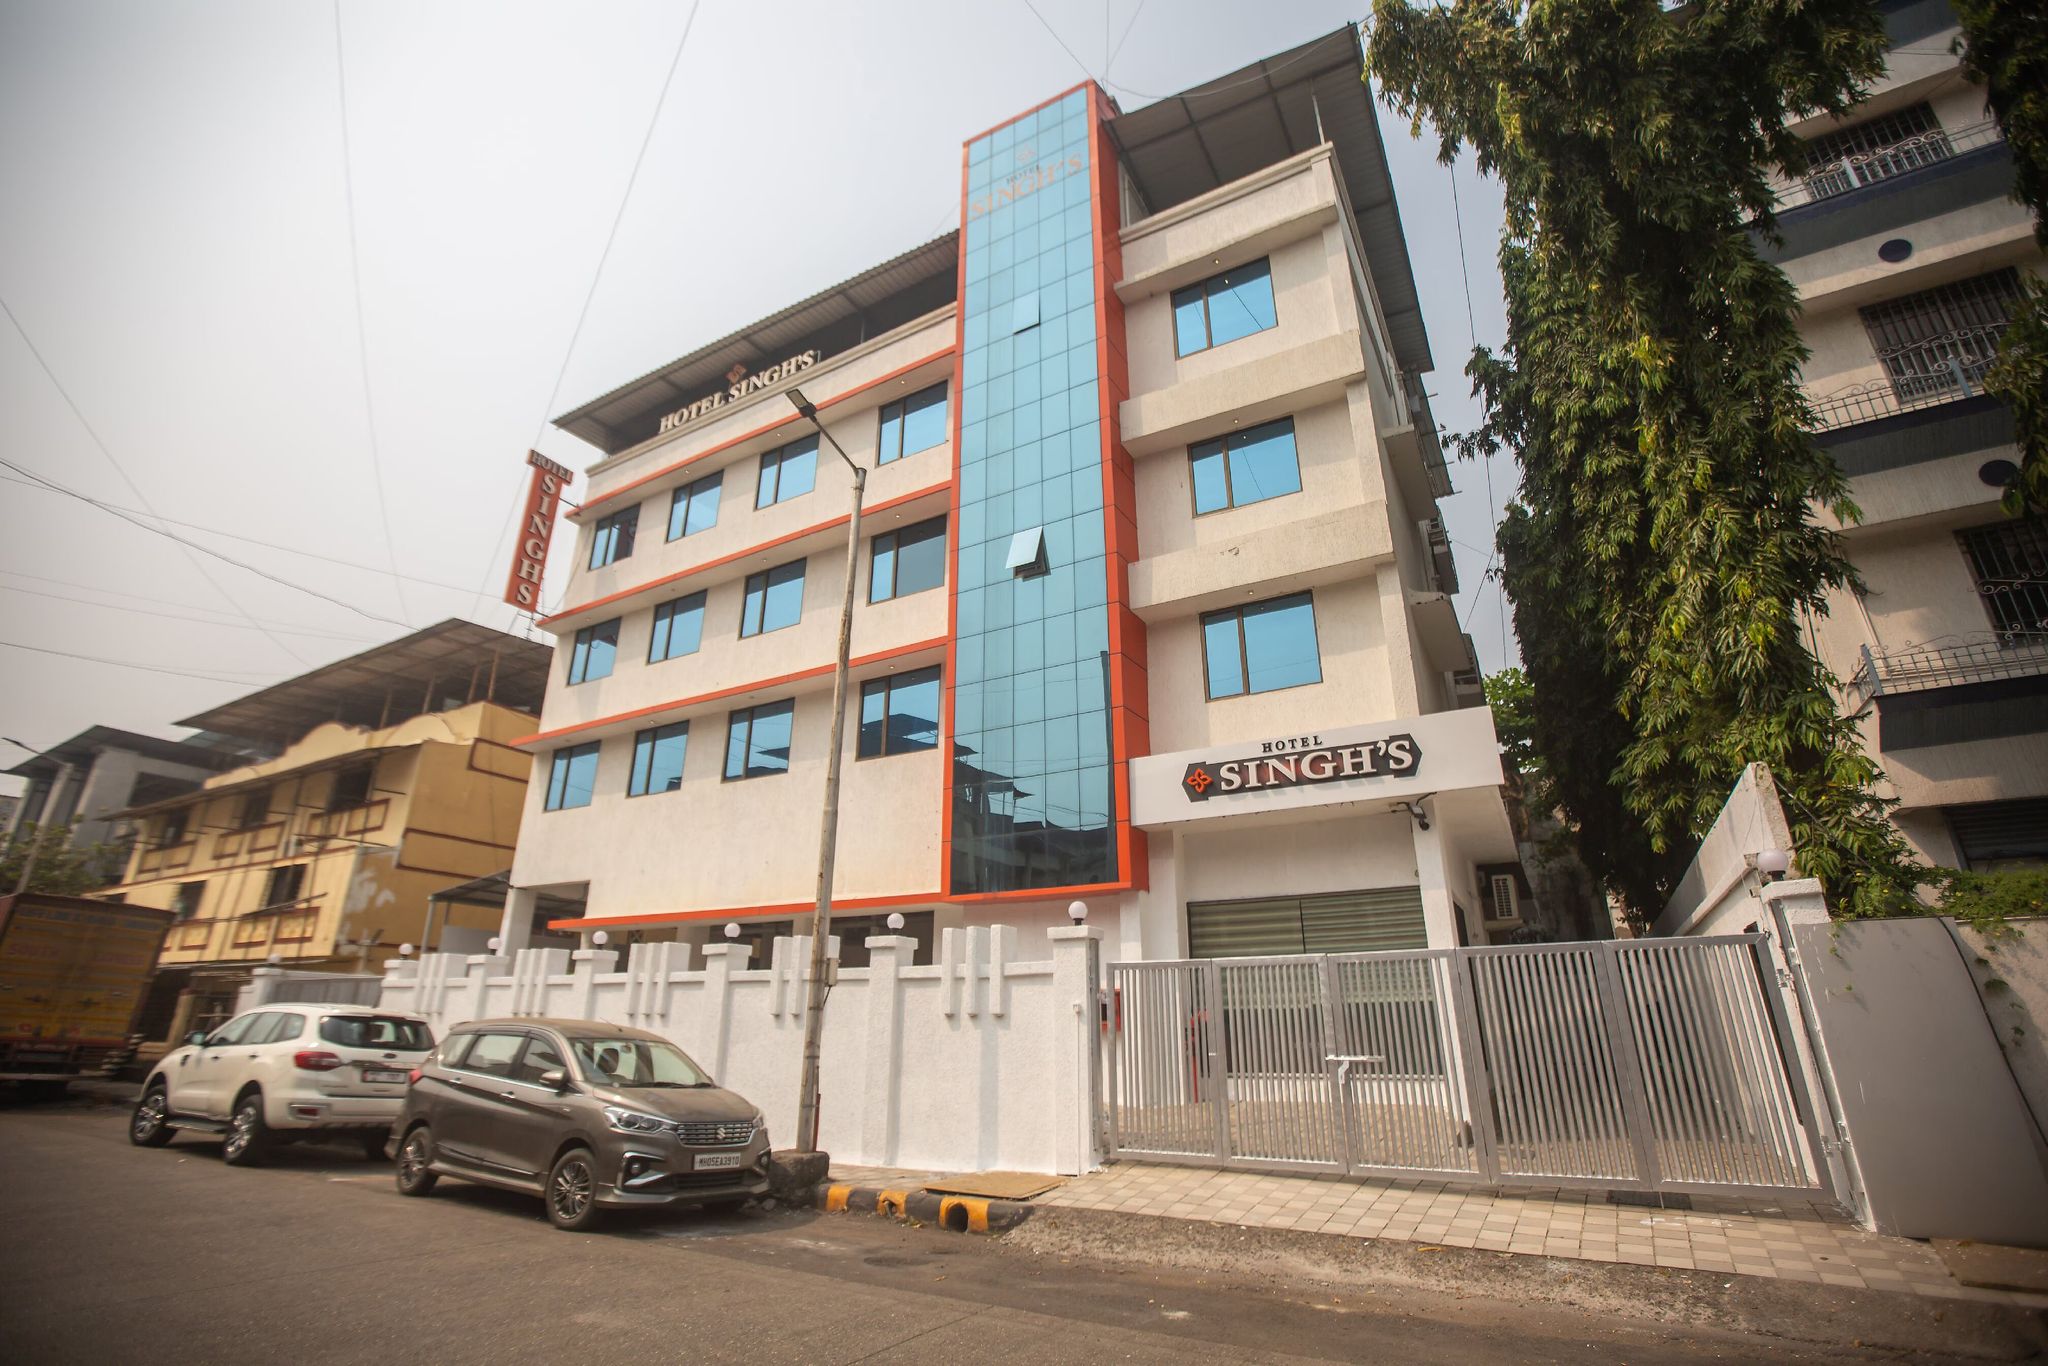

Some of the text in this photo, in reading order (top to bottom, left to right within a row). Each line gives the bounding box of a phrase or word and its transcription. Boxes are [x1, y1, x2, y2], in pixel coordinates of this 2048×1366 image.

[971, 153, 1082, 221] SINGH'S
[659, 350, 815, 433] HOTEL SINGH'S
[532, 450, 571, 480] HOTEL
[516, 474, 557, 604] SINGHS
[1219, 739, 1413, 792] SINGH'S
[1262, 735, 1323, 753] HOTEL
